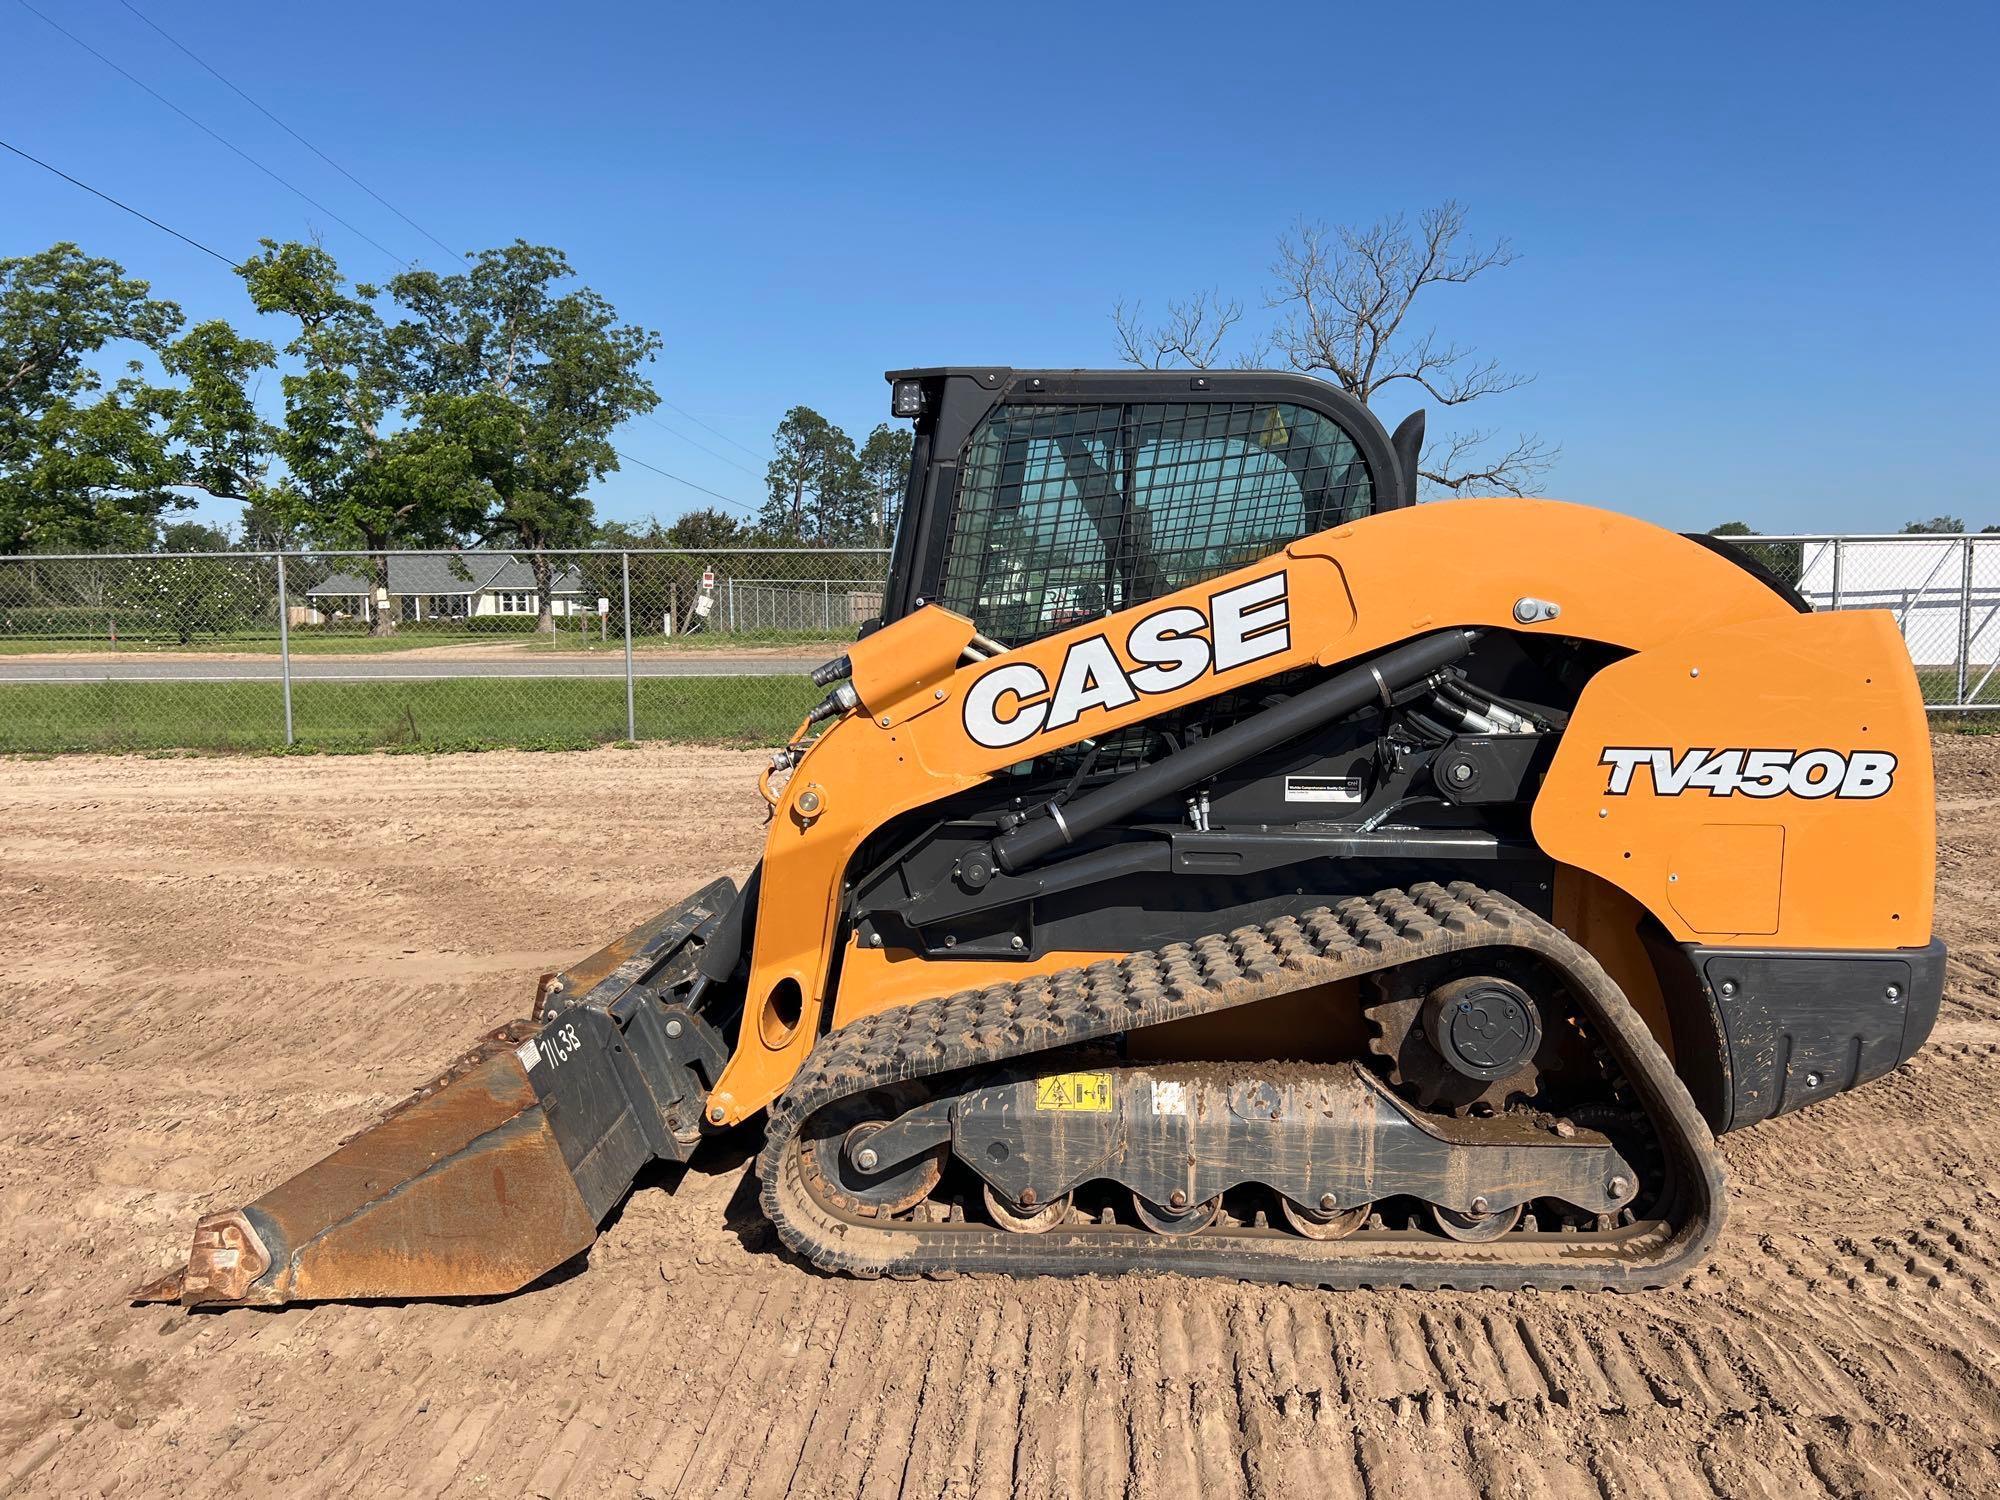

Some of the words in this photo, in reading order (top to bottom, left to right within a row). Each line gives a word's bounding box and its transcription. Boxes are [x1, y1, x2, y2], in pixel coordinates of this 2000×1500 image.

[962, 569, 1292, 748] CASE
[1598, 747, 1899, 799] TV450B
[540, 1023, 581, 1069] 7163B
